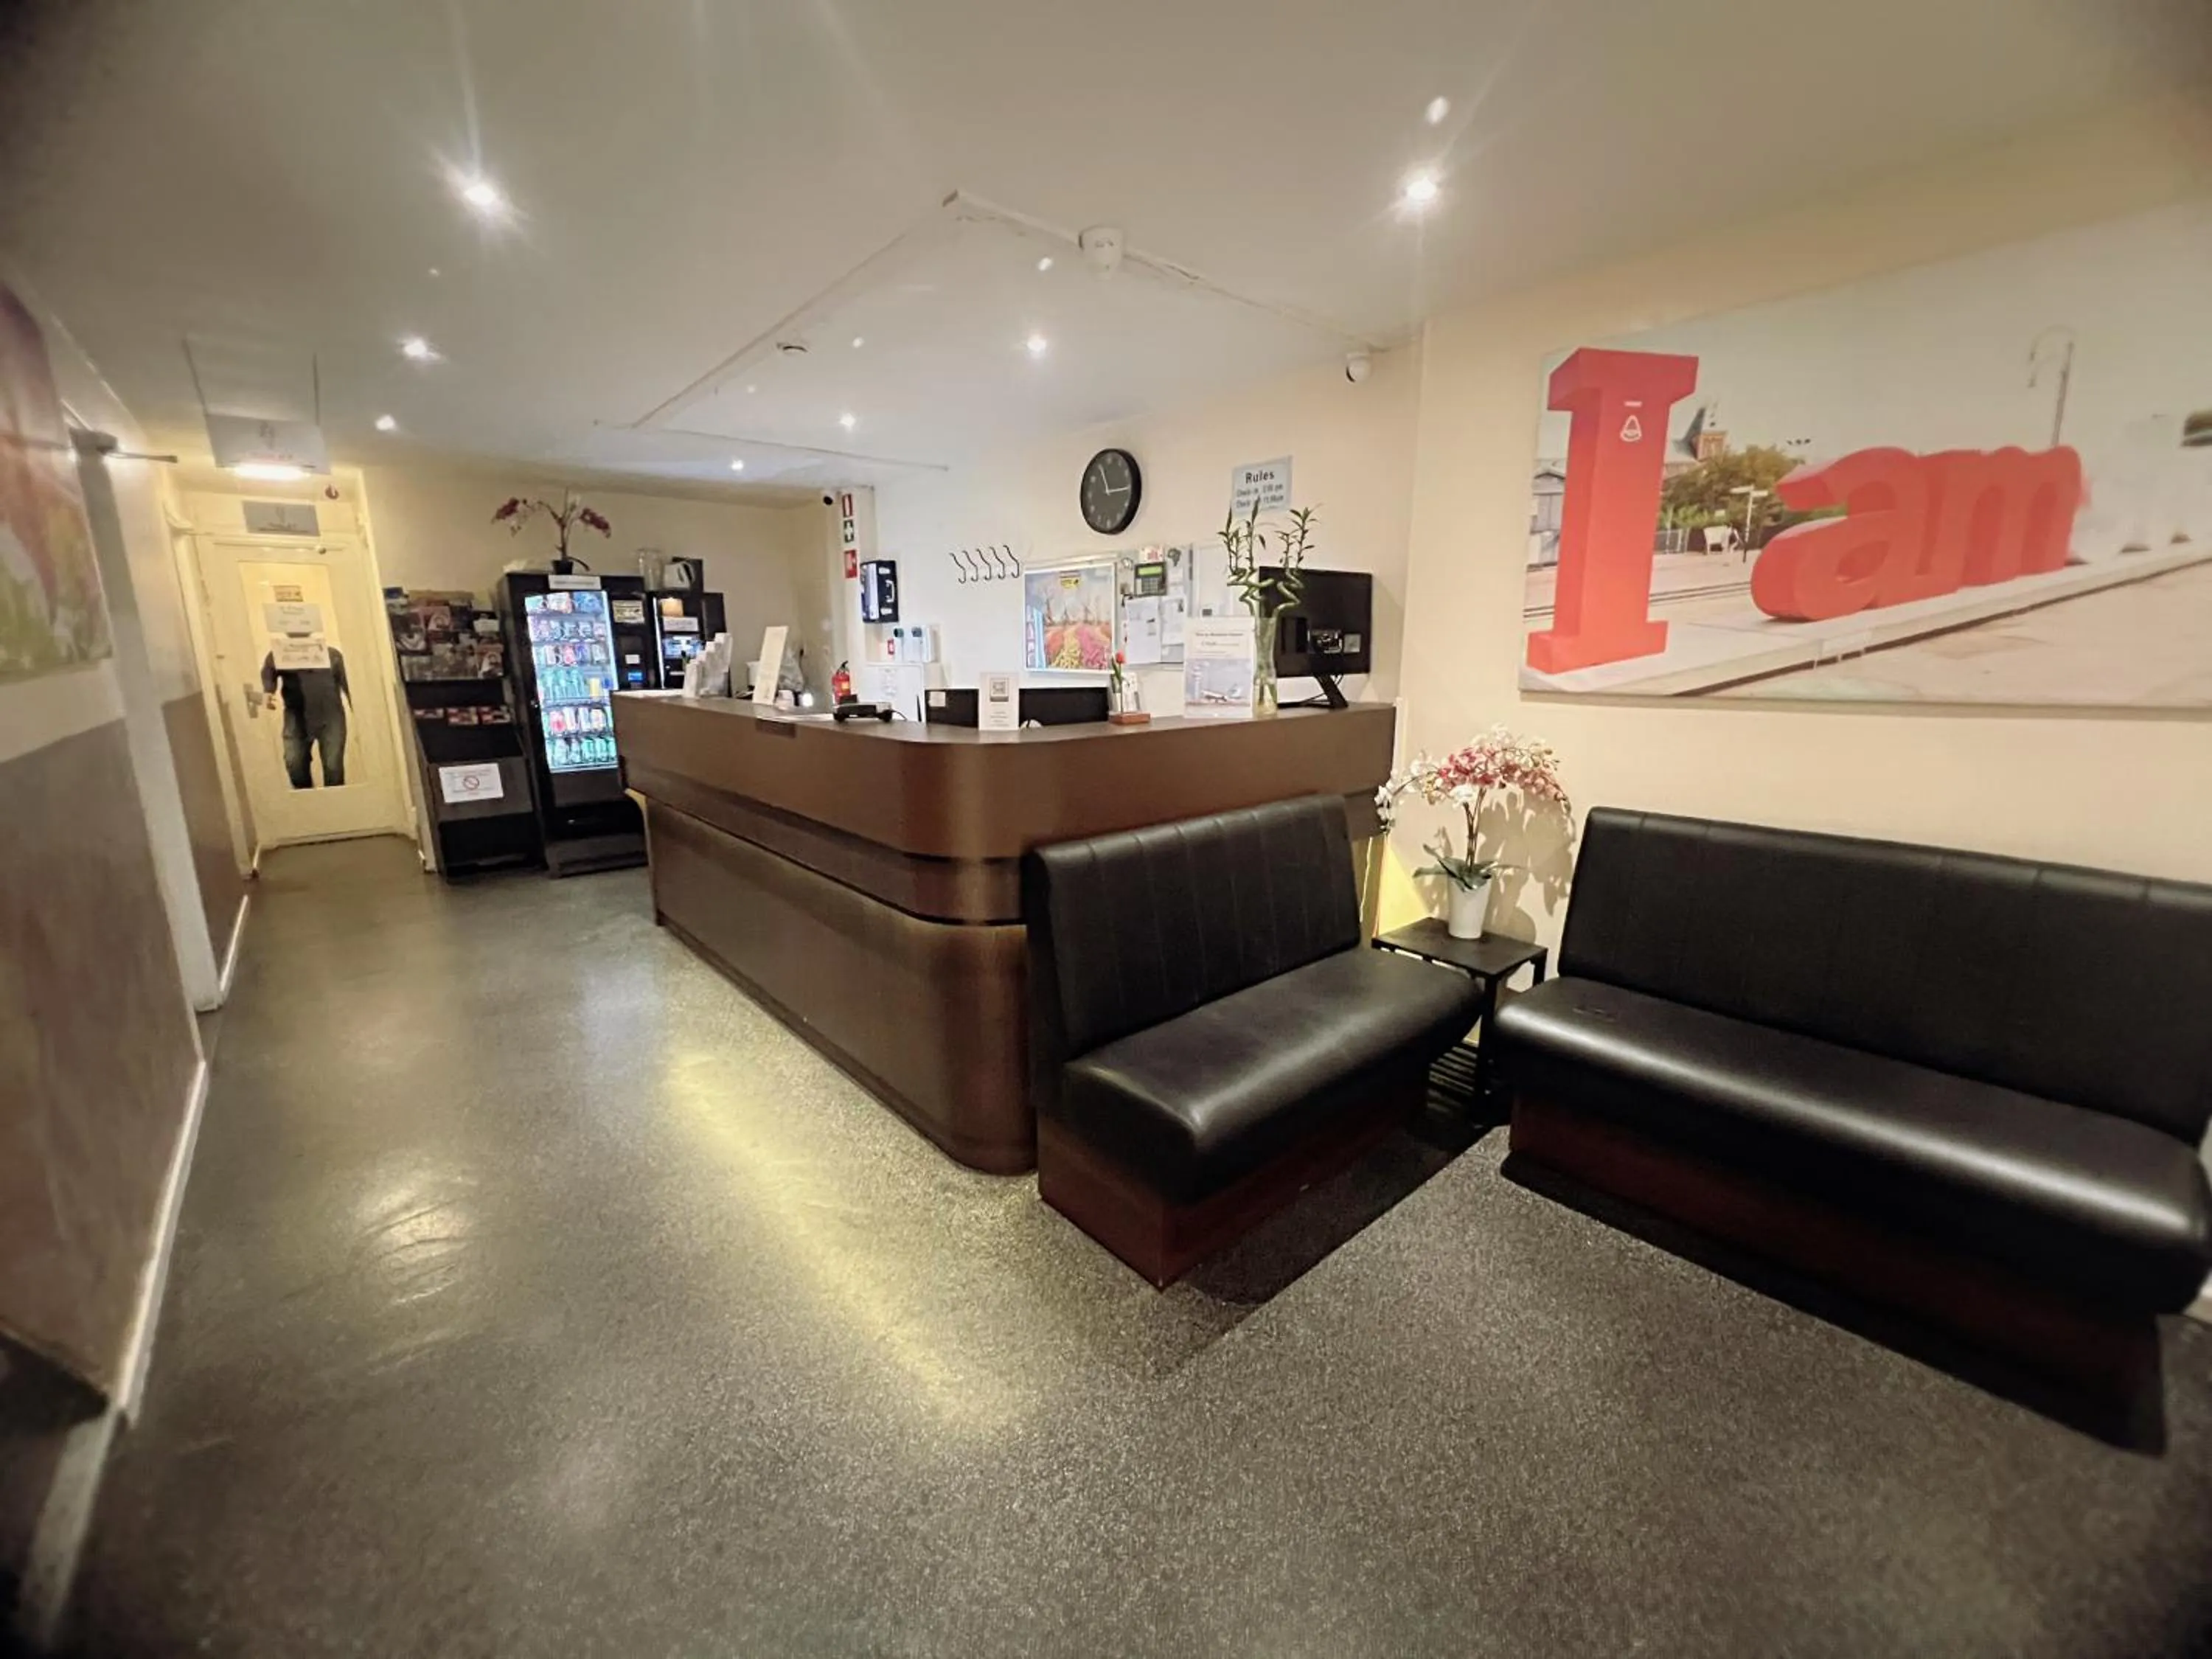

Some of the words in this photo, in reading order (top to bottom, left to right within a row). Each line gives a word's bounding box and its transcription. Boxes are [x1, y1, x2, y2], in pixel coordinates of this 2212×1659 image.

[1245, 470, 1275, 484] Rules
[1527, 347, 1699, 674] I
[1750, 445, 2086, 624] am
